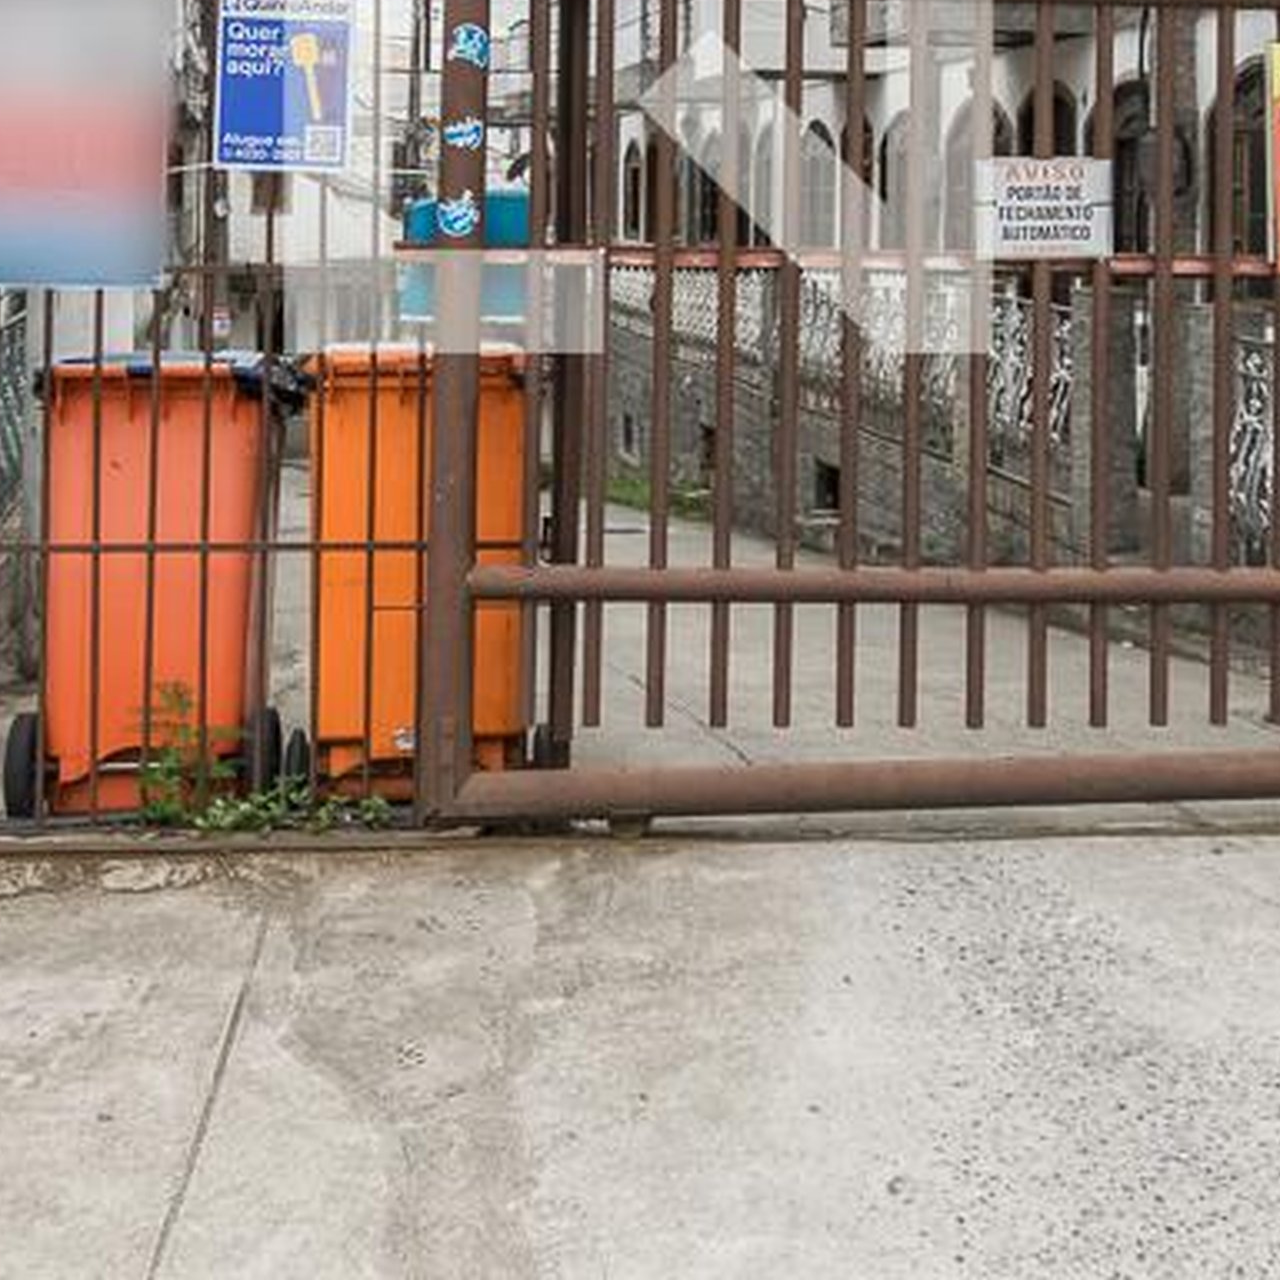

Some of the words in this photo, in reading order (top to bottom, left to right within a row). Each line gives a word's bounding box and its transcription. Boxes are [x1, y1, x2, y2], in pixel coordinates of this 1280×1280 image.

[227, 23, 281, 40] Quer
[226, 42, 289, 58] morar
[226, 57, 284, 77] aqui?
[1006, 164, 1084, 181] AVISO
[1006, 184, 1061, 200] PORTÃO
[1065, 185, 1082, 199] DE
[998, 205, 1094, 221] FECHAMENTO
